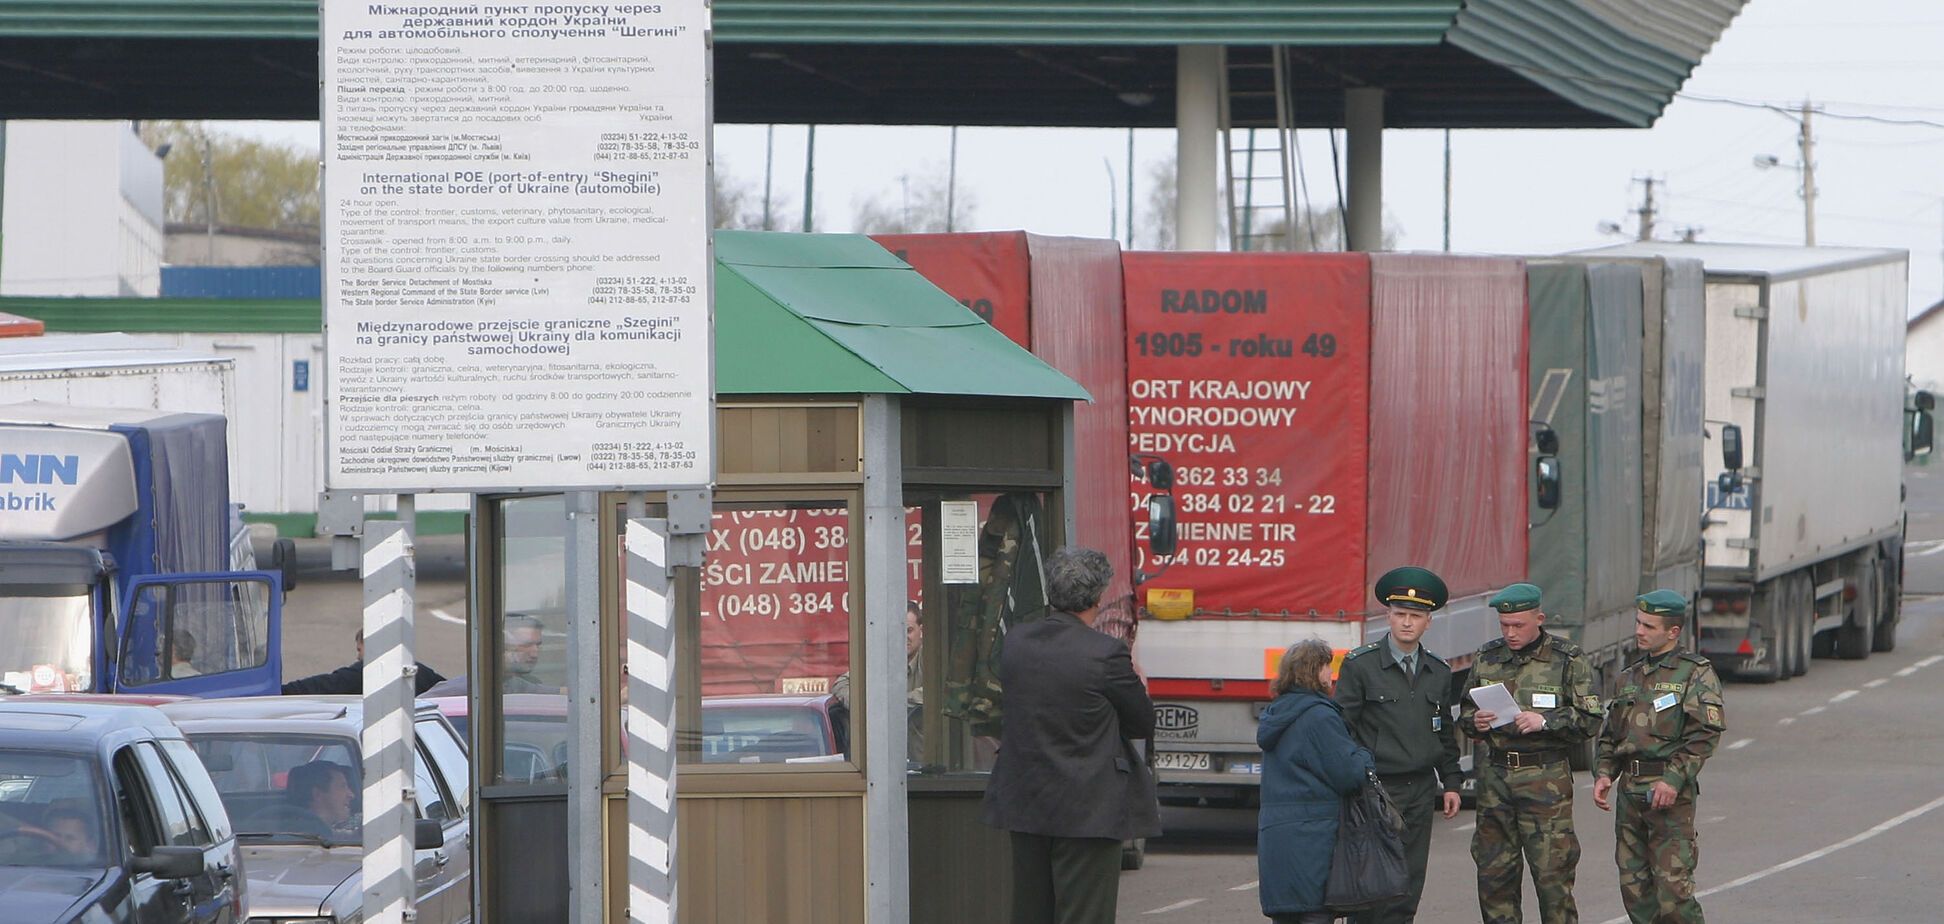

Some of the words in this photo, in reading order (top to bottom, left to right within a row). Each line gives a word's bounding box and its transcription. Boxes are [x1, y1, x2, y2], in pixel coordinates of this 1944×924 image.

[368, 4, 478, 17] Міжнародний
[484, 6, 528, 17] пункт
[534, 6, 609, 16] пропуску
[614, 5, 661, 16] через
[403, 15, 494, 28] державний
[499, 17, 558, 28] кордон
[343, 30, 372, 41] для
[378, 27, 506, 38] автомобільного
[511, 29, 606, 40] сполучення
[336, 85, 368, 93] Піший
[368, 85, 406, 95] перехід
[542, 84, 567, 93] 20:00
[600, 133, 628, 142] (03234)
[660, 132, 688, 141] 4-13-02
[596, 142, 620, 152] (0322)
[621, 142, 660, 151] 78-35-58,
[663, 141, 699, 150] 78-35-03
[593, 152, 612, 162] (044)
[613, 152, 652, 161] 212-88-65,
[653, 152, 688, 160] 212-87-63
[362, 172, 449, 182] International
[454, 171, 483, 182] POE
[488, 171, 588, 184] (port-of-entry)
[360, 186, 377, 195] on
[382, 184, 404, 194] the
[408, 184, 443, 194] state
[448, 183, 494, 194] border
[498, 183, 512, 194] of
[517, 183, 570, 194] Ukraine
[574, 183, 660, 196] (automobile)
[353, 198, 373, 207] hour
[341, 278, 354, 286] The
[355, 278, 379, 286] Border
[381, 278, 407, 286] Service
[408, 278, 450, 286] Detachment
[451, 278, 460, 286] of
[461, 278, 492, 286] Mostiska
[595, 277, 624, 287] (03234)
[625, 277, 658, 287] 51-222,
[659, 277, 688, 285] 4-13-02
[340, 288, 369, 296] Western
[370, 288, 400, 297] Regional
[401, 288, 436, 296] Command
[437, 287, 445, 296] of
[446, 287, 458, 296] the
[459, 287, 478, 296] State
[479, 287, 503, 295] Border
[504, 287, 530, 295] service
[530, 287, 549, 296] (Lviv)
[592, 287, 616, 296] (0322)
[618, 286, 658, 296] 78-35-58,
[660, 286, 696, 294] 78-35-03
[340, 298, 354, 306] The
[354, 298, 374, 306] State
[374, 297, 398, 306] border
[399, 297, 424, 306] Service
[426, 297, 475, 305] Administration
[476, 297, 496, 306] (Kyiv)
[587, 296, 607, 306] (044)
[608, 296, 650, 306] 212-88-65,
[651, 296, 690, 304] 212-87-63
[1161, 290, 1267, 314] RADOM
[961, 299, 994, 325] 9
[357, 321, 474, 334] Międzynarodowe
[478, 319, 540, 332] przejscie
[544, 318, 611, 331] graniczne
[356, 336, 372, 345] na
[377, 333, 428, 346] granicy
[432, 332, 514, 345] państwowej
[518, 331, 570, 344] Ukrainy
[574, 330, 595, 341] dla
[600, 330, 681, 343] komunikacji
[1135, 332, 1203, 357] 1905
[1229, 334, 1293, 357] roku
[1302, 333, 1337, 357] 49
[467, 344, 570, 357] samochodowej
[1129, 379, 1183, 399] ORT
[1189, 380, 1312, 400] KRAJOWY
[384, 393, 396, 402] dla
[400, 393, 438, 403] pieszych
[516, 392, 548, 402] godziny
[586, 391, 618, 401] godziny
[591, 442, 622, 452] (03234)
[623, 442, 654, 452] 51-222,
[655, 442, 684, 450] 4-13-02
[590, 452, 616, 462] (0322)
[618, 452, 659, 462] 78-35-58,
[659, 452, 696, 460] 78-35-03
[586, 462, 606, 472] (044)
[608, 462, 651, 471] 212-88-65,
[653, 461, 693, 469] 212-87-63
[1177, 467, 1216, 486] 362
[1223, 468, 1249, 487] 33
[1256, 468, 1283, 487] 34
[1181, 493, 1221, 513] 384
[1228, 494, 1254, 514] 02
[1261, 495, 1286, 514] 21
[1308, 496, 1336, 515] 22
[1136, 522, 1253, 541] ZIENNE
[1259, 524, 1296, 541] TIR
[740, 526, 807, 557] (048)
[815, 526, 848, 549] 38
[1195, 549, 1220, 567] 02
[1226, 549, 1286, 568] 24-25
[701, 560, 752, 586] ŚCI
[760, 561, 848, 585] ZAMIE
[718, 592, 781, 622] (048)
[789, 592, 834, 615] 384
